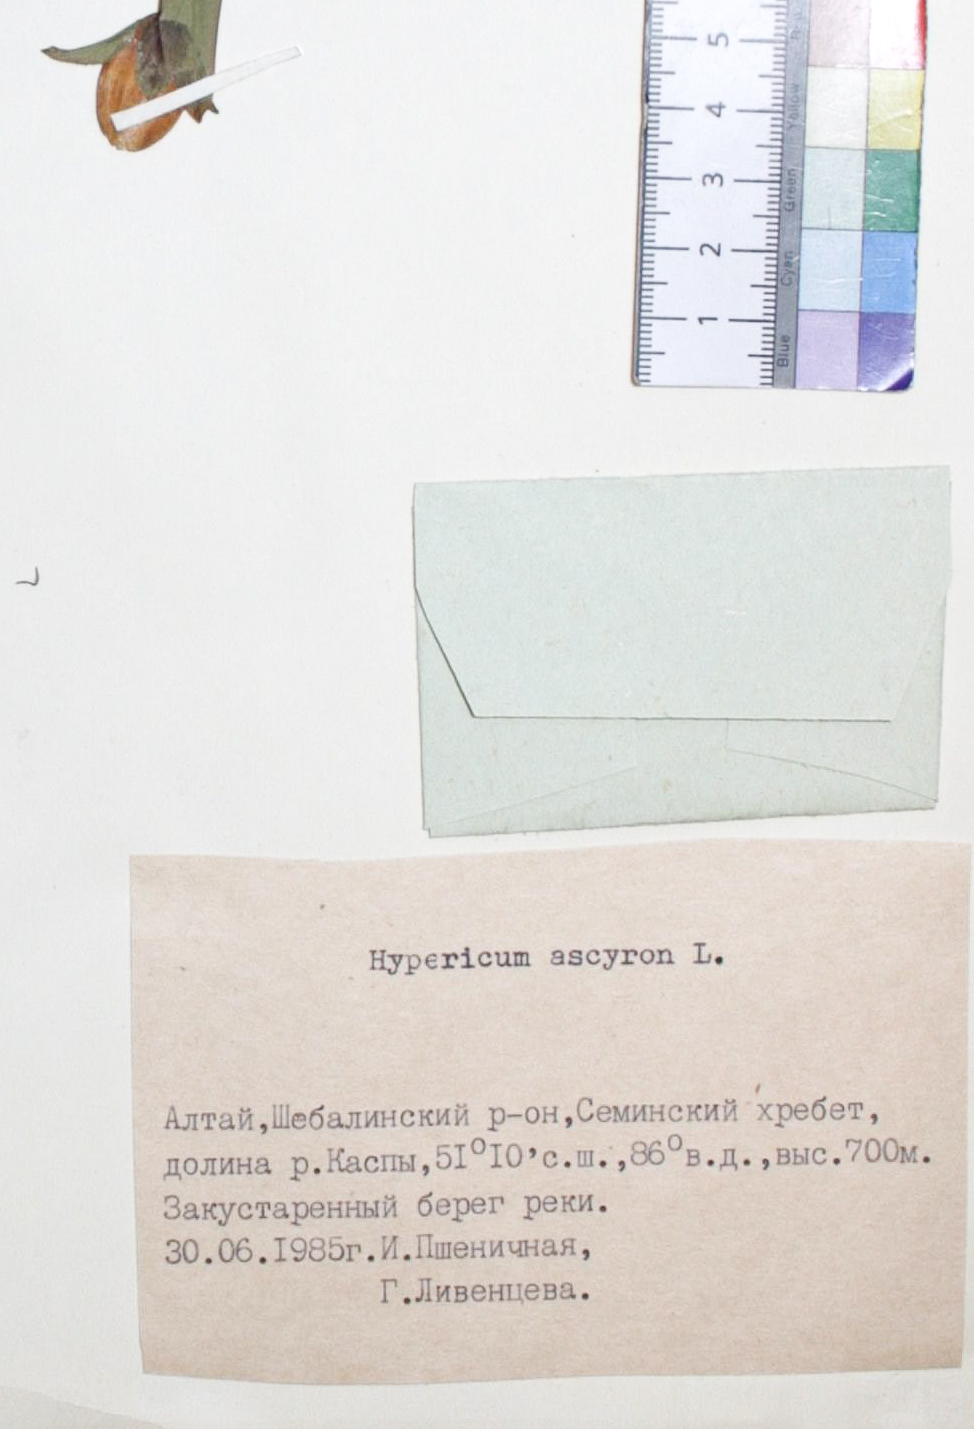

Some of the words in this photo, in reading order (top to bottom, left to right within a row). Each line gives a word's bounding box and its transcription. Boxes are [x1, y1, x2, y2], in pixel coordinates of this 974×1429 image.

[708, 33, 729, 48] 5
[705, 101, 727, 118] 4
[702, 172, 725, 187] 3
[784, 168, 797, 213] Green
[699, 242, 721, 257] 2
[780, 250, 794, 287] Cyan
[697, 315, 719, 325] 1
[777, 334, 790, 368] Blue
[369, 945, 532, 975] Hypericum
[550, 946, 676, 970] ascyron
[693, 941, 725, 966] L.
[756, 1096, 880, 1129] хребет,
[163, 1154, 272, 1181] долина
[163, 1194, 398, 1227] Закустаренный
[418, 1192, 505, 1222] берег
[523, 1191, 608, 1221] реки.
[380, 1276, 591, 1306] Г.Ливенцева.
